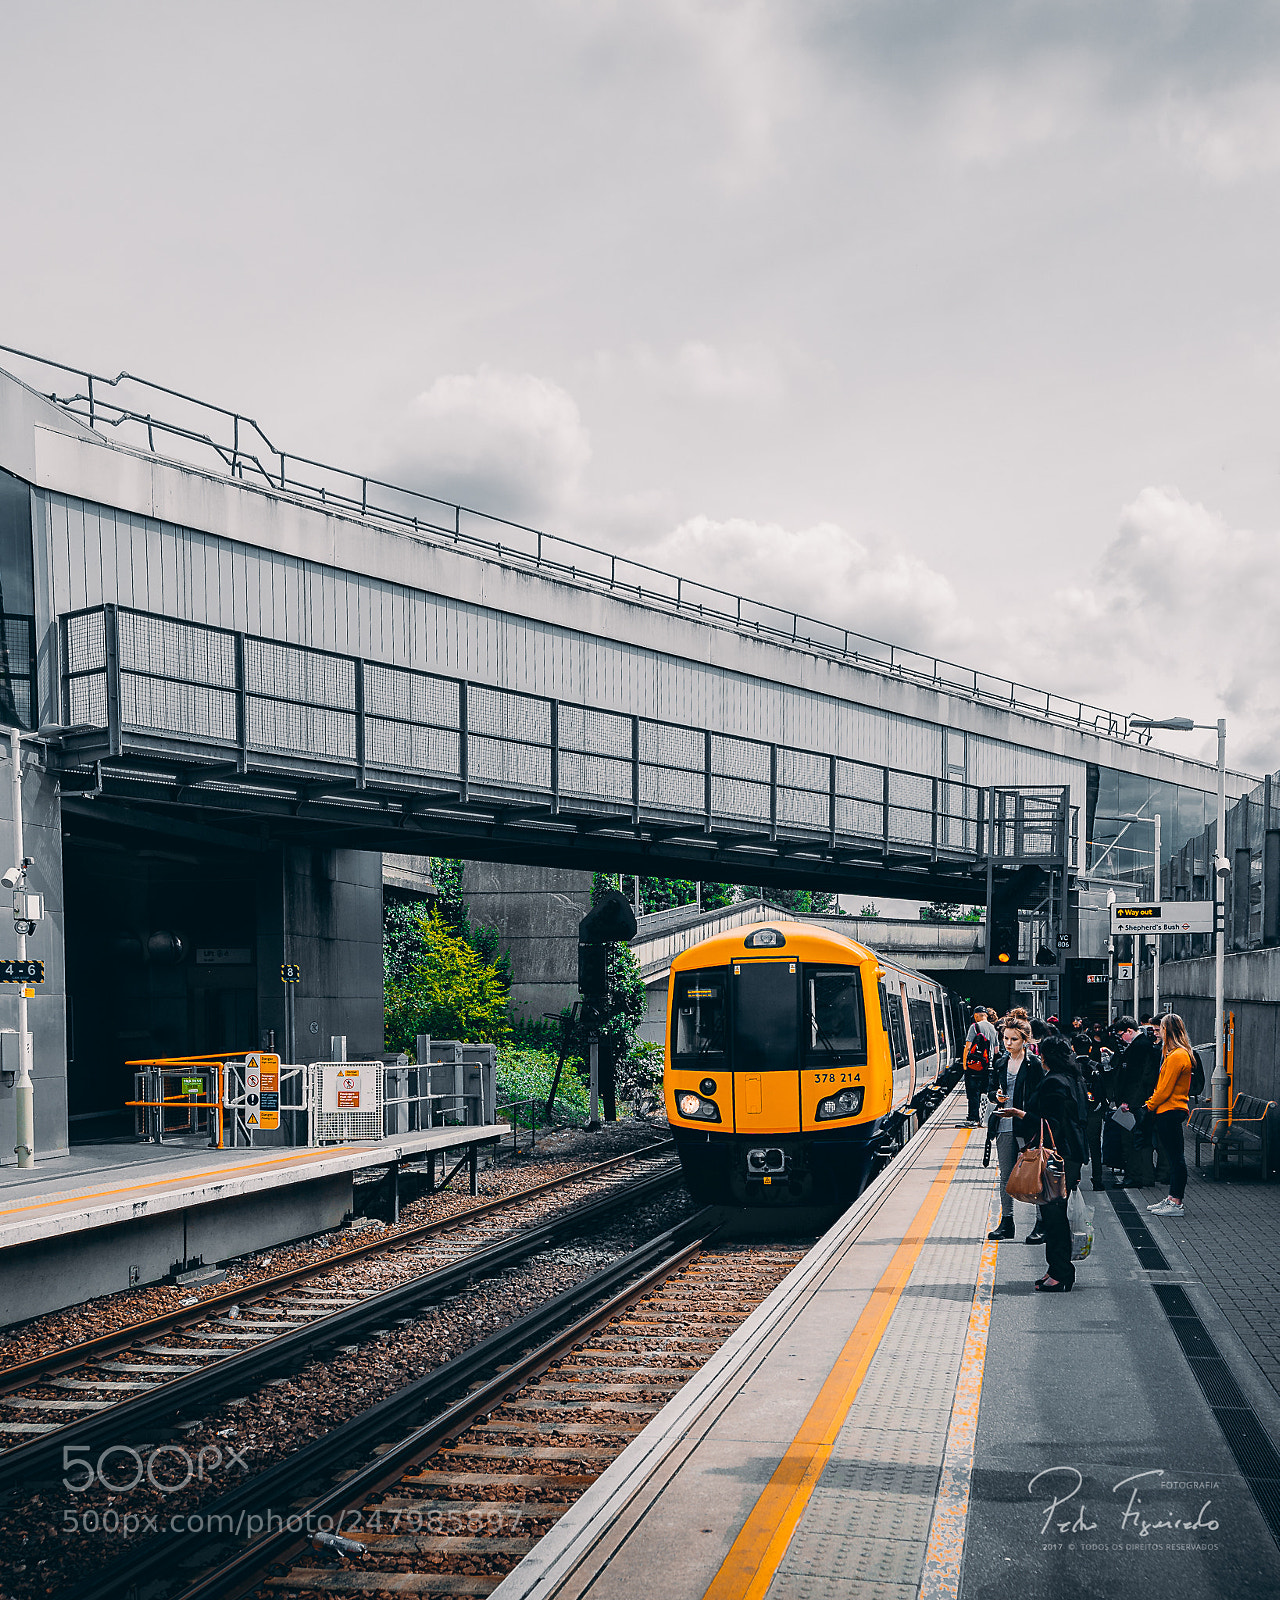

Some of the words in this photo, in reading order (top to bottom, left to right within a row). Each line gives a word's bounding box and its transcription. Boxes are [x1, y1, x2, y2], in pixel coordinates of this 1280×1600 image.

[1124, 908, 1139, 917] Way
[5, 964, 14, 976] 4
[27, 964, 36, 976] 6
[287, 967, 294, 977] 8
[1122, 968, 1129, 978] 2
[814, 1073, 836, 1084] 378
[840, 1072, 861, 1083] 214
